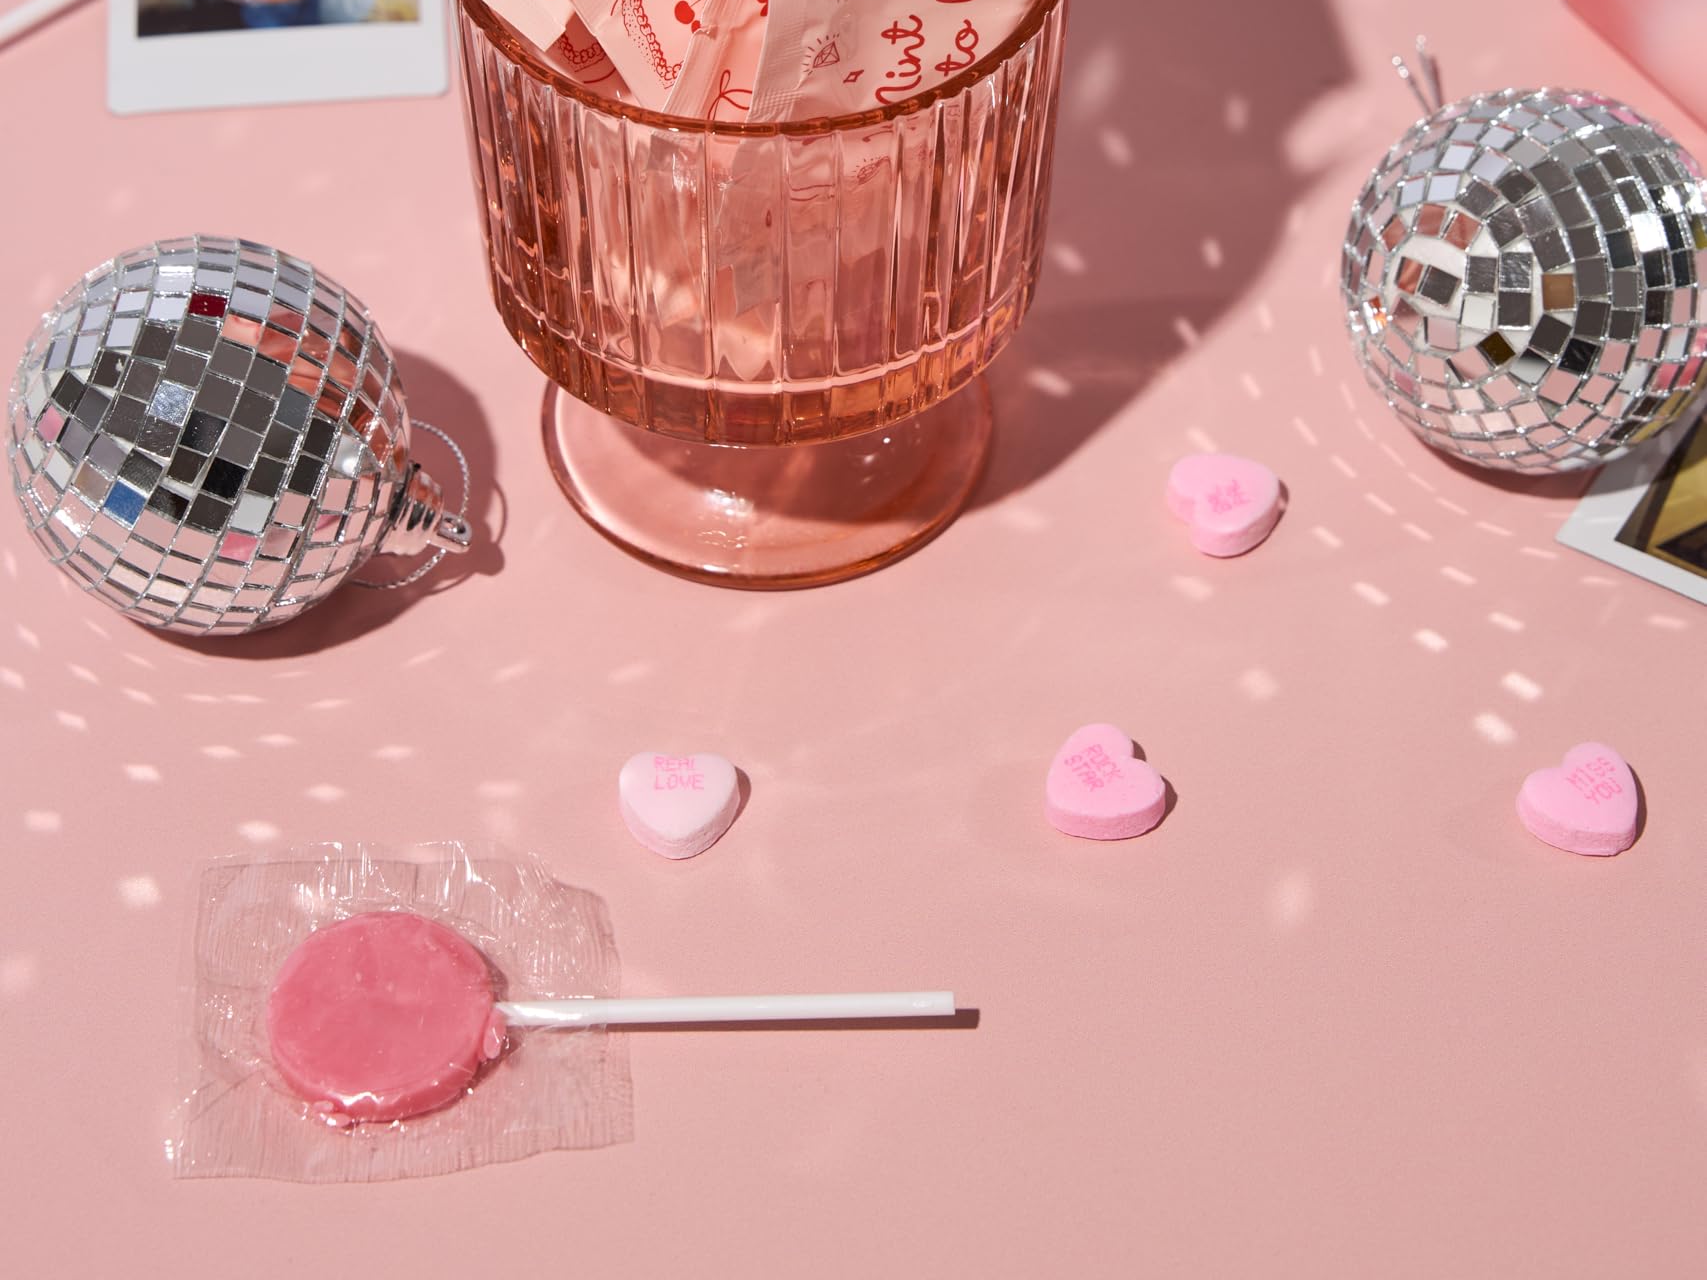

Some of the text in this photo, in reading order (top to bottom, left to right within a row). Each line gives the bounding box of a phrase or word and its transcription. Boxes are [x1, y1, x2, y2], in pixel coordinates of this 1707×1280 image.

[935, 20, 979, 76] to
[655, 774, 704, 790] LOVE
[1566, 757, 1616, 791] MISS
[1584, 777, 1622, 804] YOU
